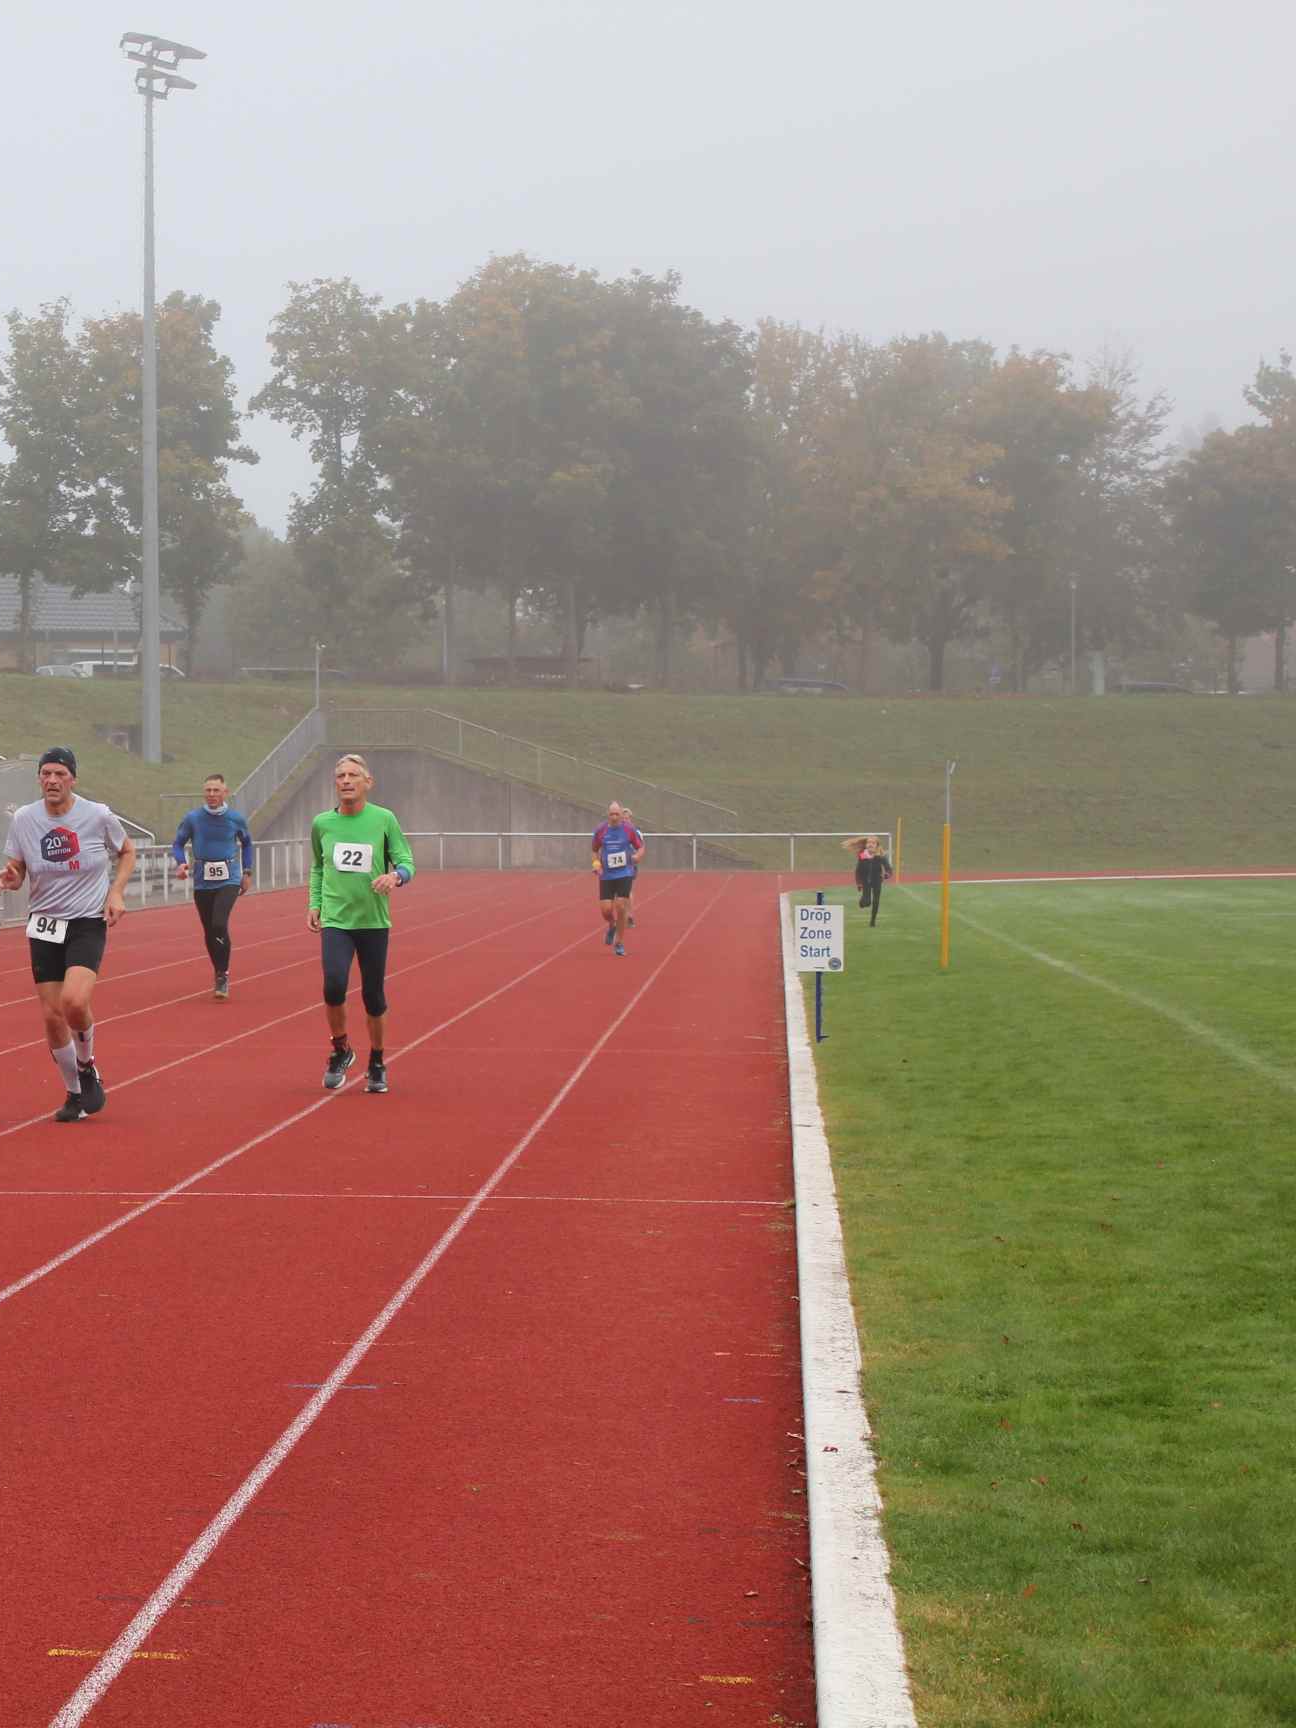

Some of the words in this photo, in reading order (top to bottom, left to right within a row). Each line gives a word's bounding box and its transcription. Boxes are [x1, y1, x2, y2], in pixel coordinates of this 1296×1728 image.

[47, 847, 72, 857] EDITION
[341, 850, 363, 867] 22
[209, 866, 223, 877] 95
[800, 908, 832, 924] Drop
[36, 917, 57, 936] 94
[799, 926, 833, 940] Zone
[799, 944, 831, 958] Start
